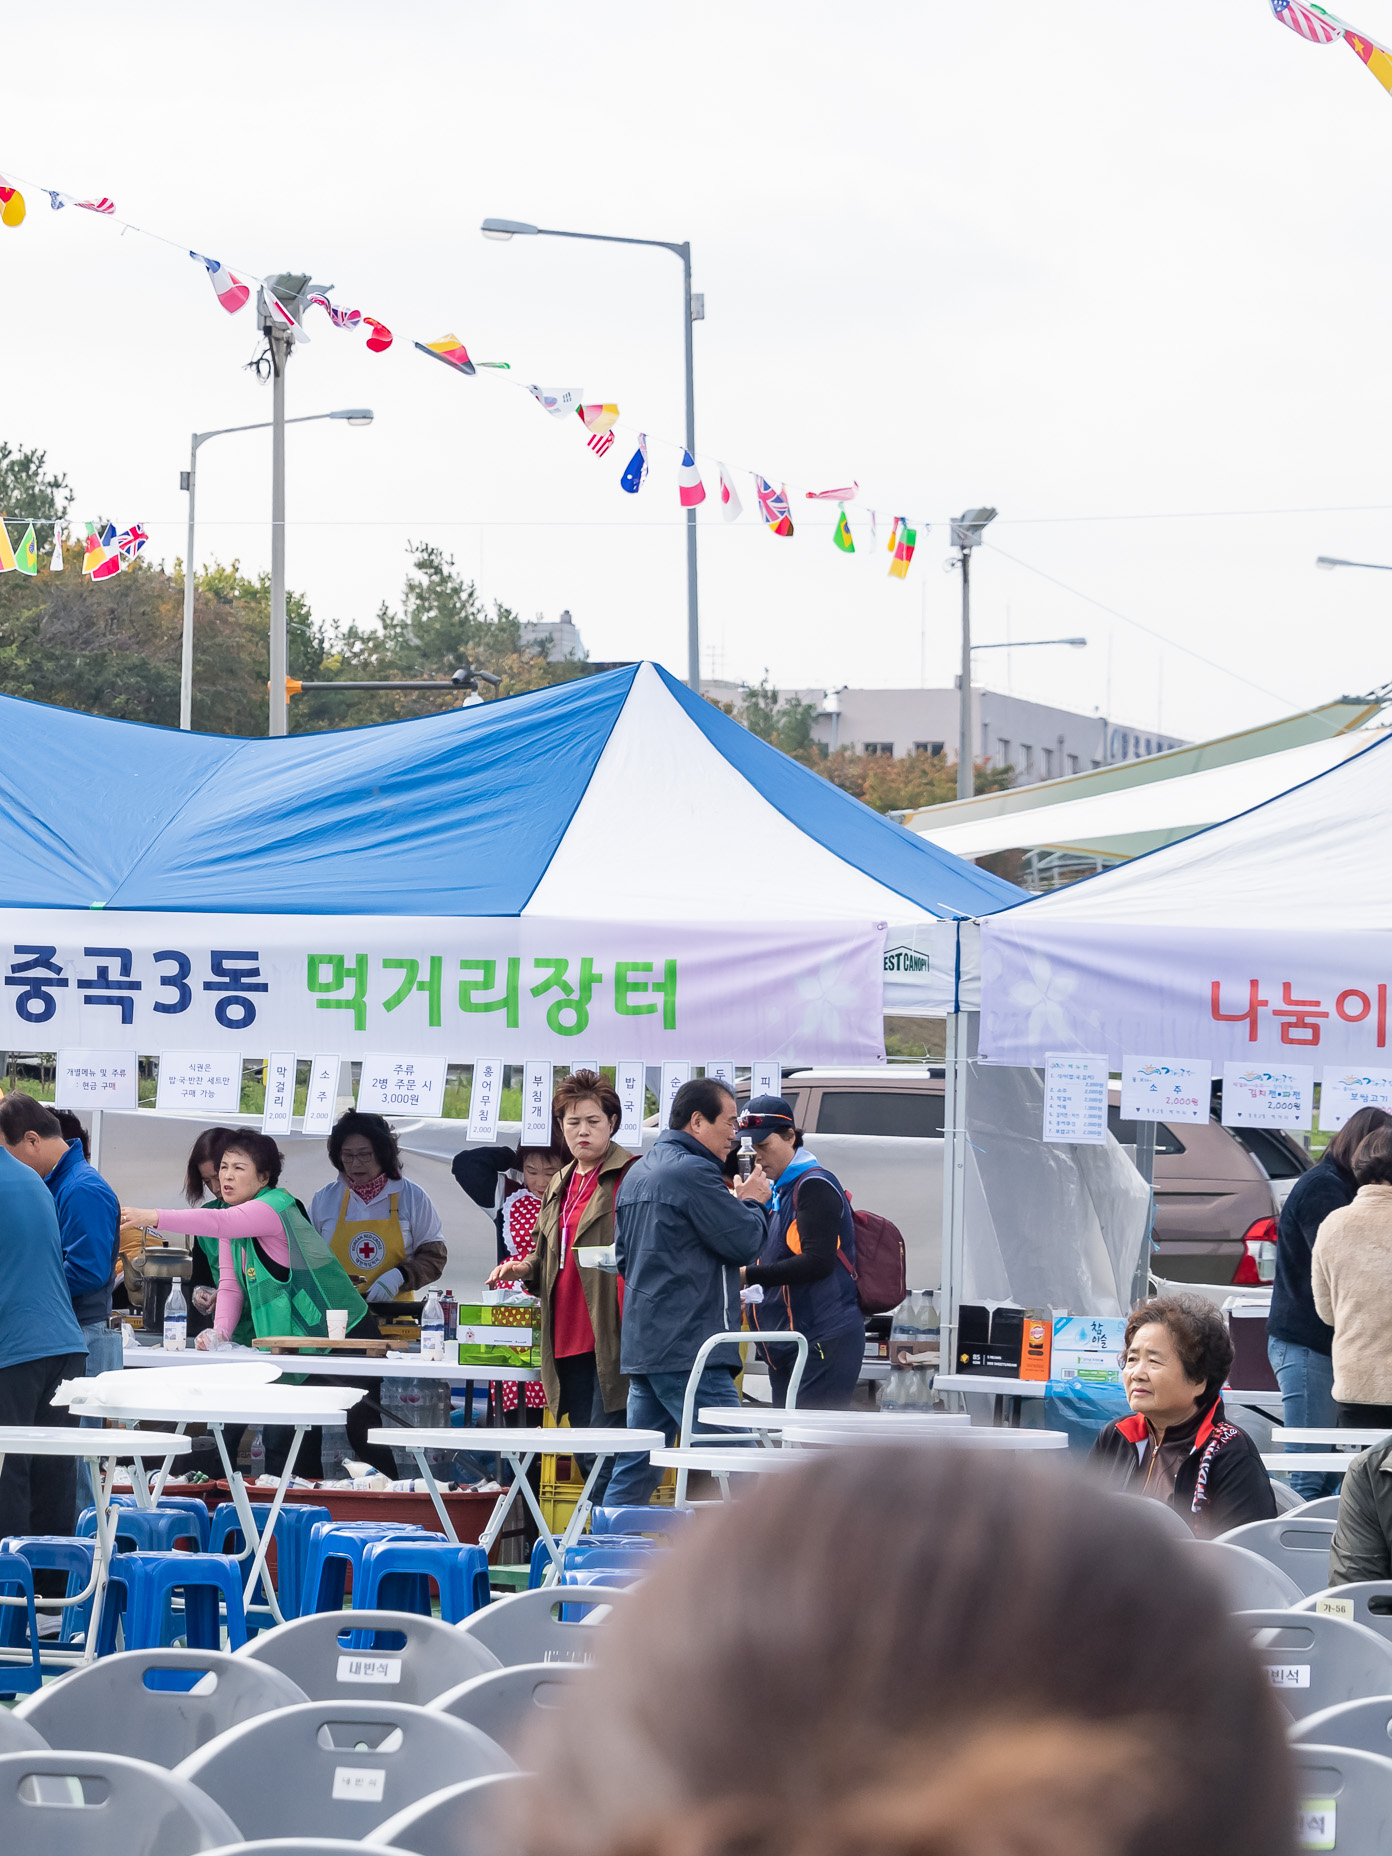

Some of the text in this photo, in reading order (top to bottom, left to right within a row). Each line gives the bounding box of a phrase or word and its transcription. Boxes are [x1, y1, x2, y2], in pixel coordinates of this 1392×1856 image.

[4, 944, 270, 1030] 중곡3동
[306, 953, 679, 1037] 먹거리장터
[1210, 979, 1387, 1048] 나눔이
[274, 1066, 288, 1107] 막걸리
[372, 1078, 432, 1091] 2병 주문 시
[393, 1064, 414, 1076] 주류
[381, 1093, 419, 1106] 3,000원
[478, 1065, 494, 1121] 홍어무침
[531, 1076, 543, 1117] 부침개
[1266, 1669, 1299, 1684] 빈석
